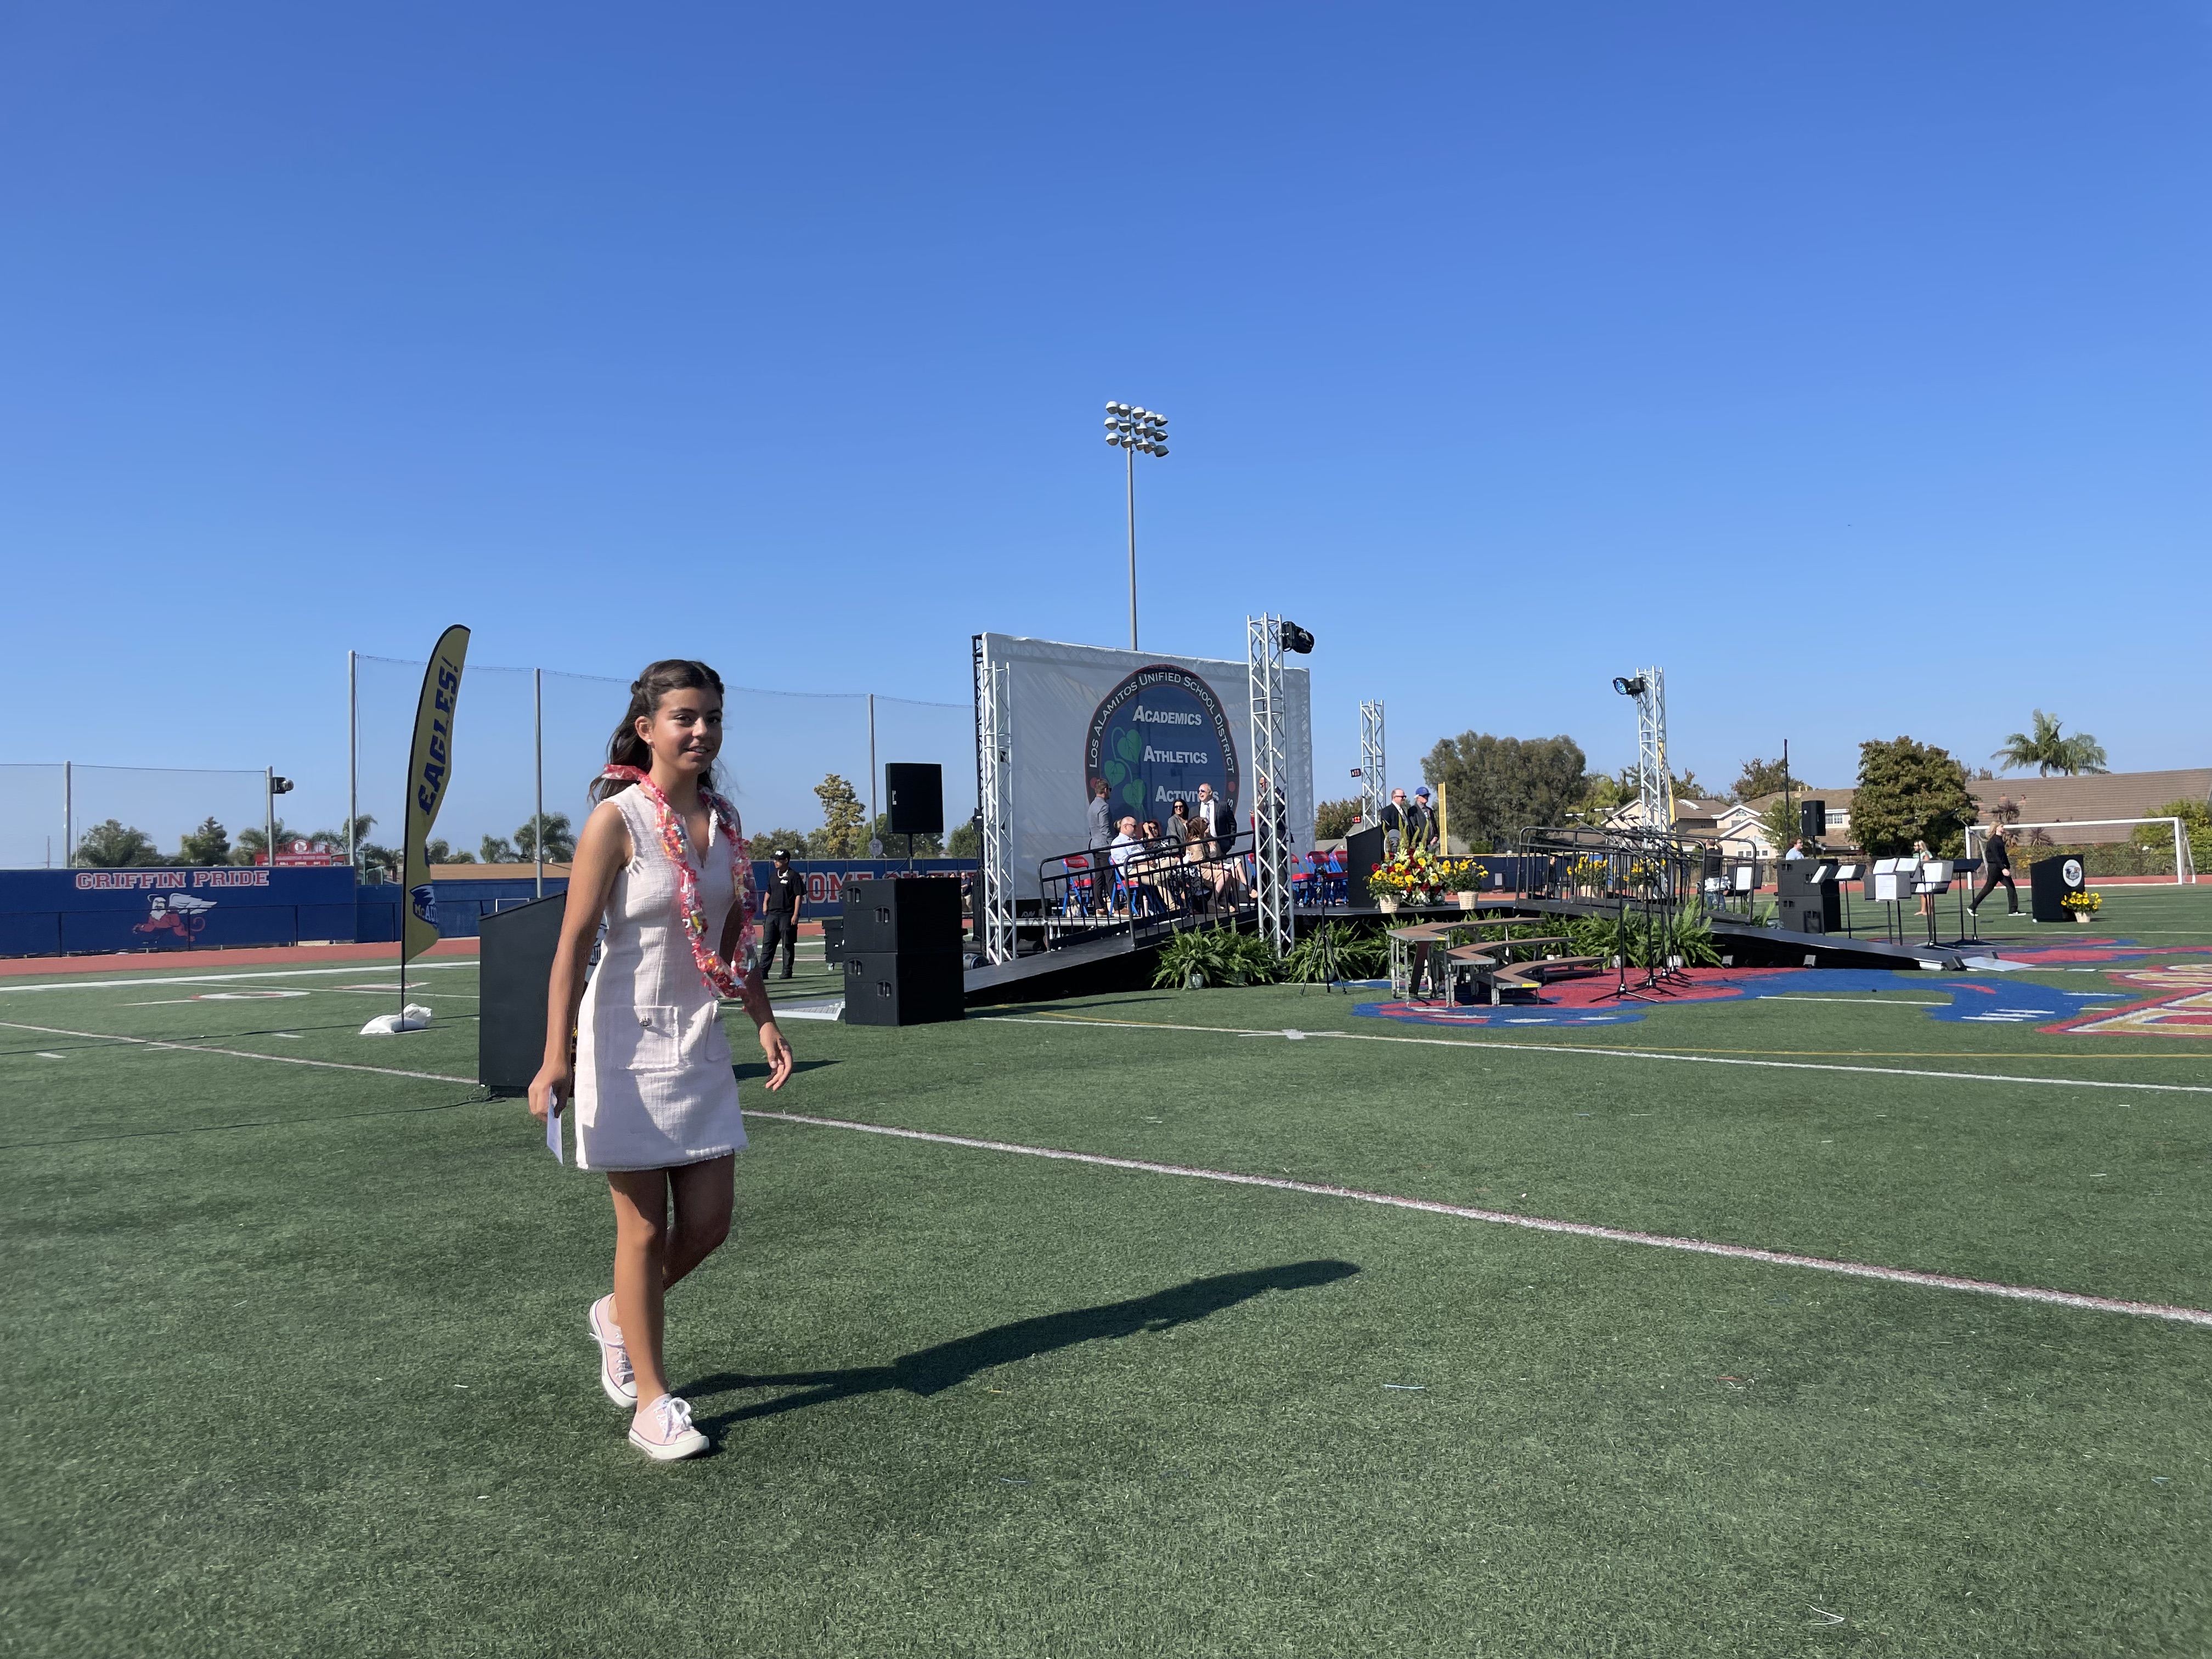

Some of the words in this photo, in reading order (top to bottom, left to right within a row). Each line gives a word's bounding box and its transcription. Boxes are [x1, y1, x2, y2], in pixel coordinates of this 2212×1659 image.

[1138, 672, 1181, 686] UNIFIED
[1093, 681, 1138, 737] ALAMITOS
[1183, 676, 1214, 715] SCHOOL
[1132, 705, 1202, 726] ACADEMICS
[417, 656, 459, 815] EAGLES!
[1214, 713, 1234, 774] DISTRICT
[1089, 738, 1099, 768] LOS
[1143, 745, 1208, 764] ATHLETICS
[76, 872, 187, 890] GRIFFIN
[193, 870, 269, 888] PRIDE
